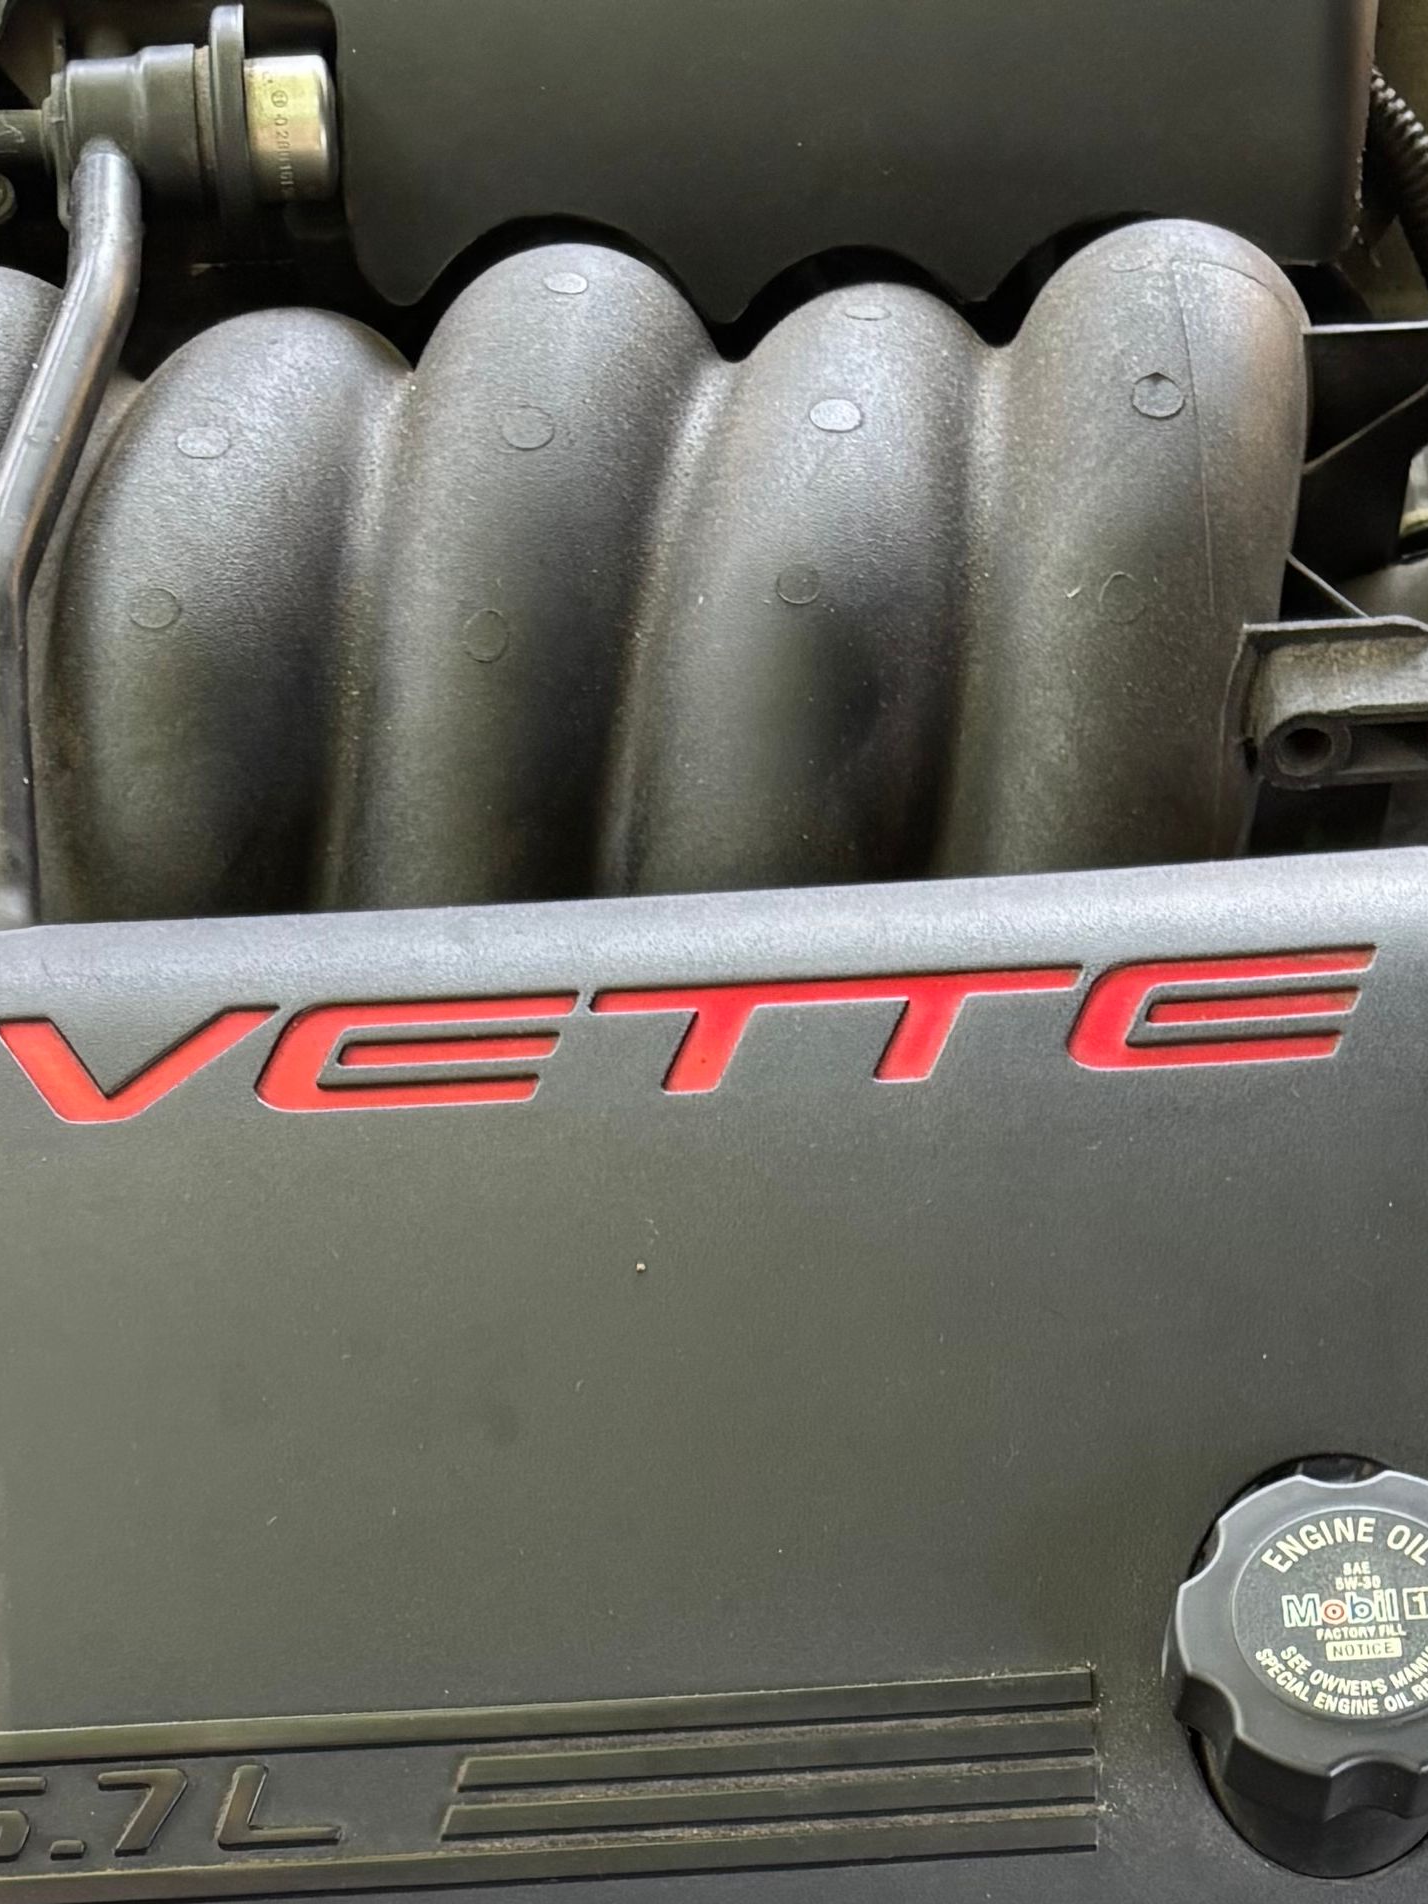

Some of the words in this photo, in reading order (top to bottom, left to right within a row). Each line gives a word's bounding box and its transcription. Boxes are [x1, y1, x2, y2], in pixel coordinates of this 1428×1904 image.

[1260, 1516, 1377, 1573] ENGINE
[1342, 1561, 1371, 1575] SAE
[1281, 1588, 1400, 1628] Mobil
[1316, 1627, 1375, 1640] FACTORY
[1332, 1641, 1395, 1658] NOTICE
[1255, 1648, 1312, 1702] SPECIAL
[1313, 1691, 1380, 1716] ENGINE
[1383, 1692, 1415, 1713] OIL
[1280, 1645, 1312, 1676] SEE
[1309, 1668, 1388, 1696] OWNER'S
